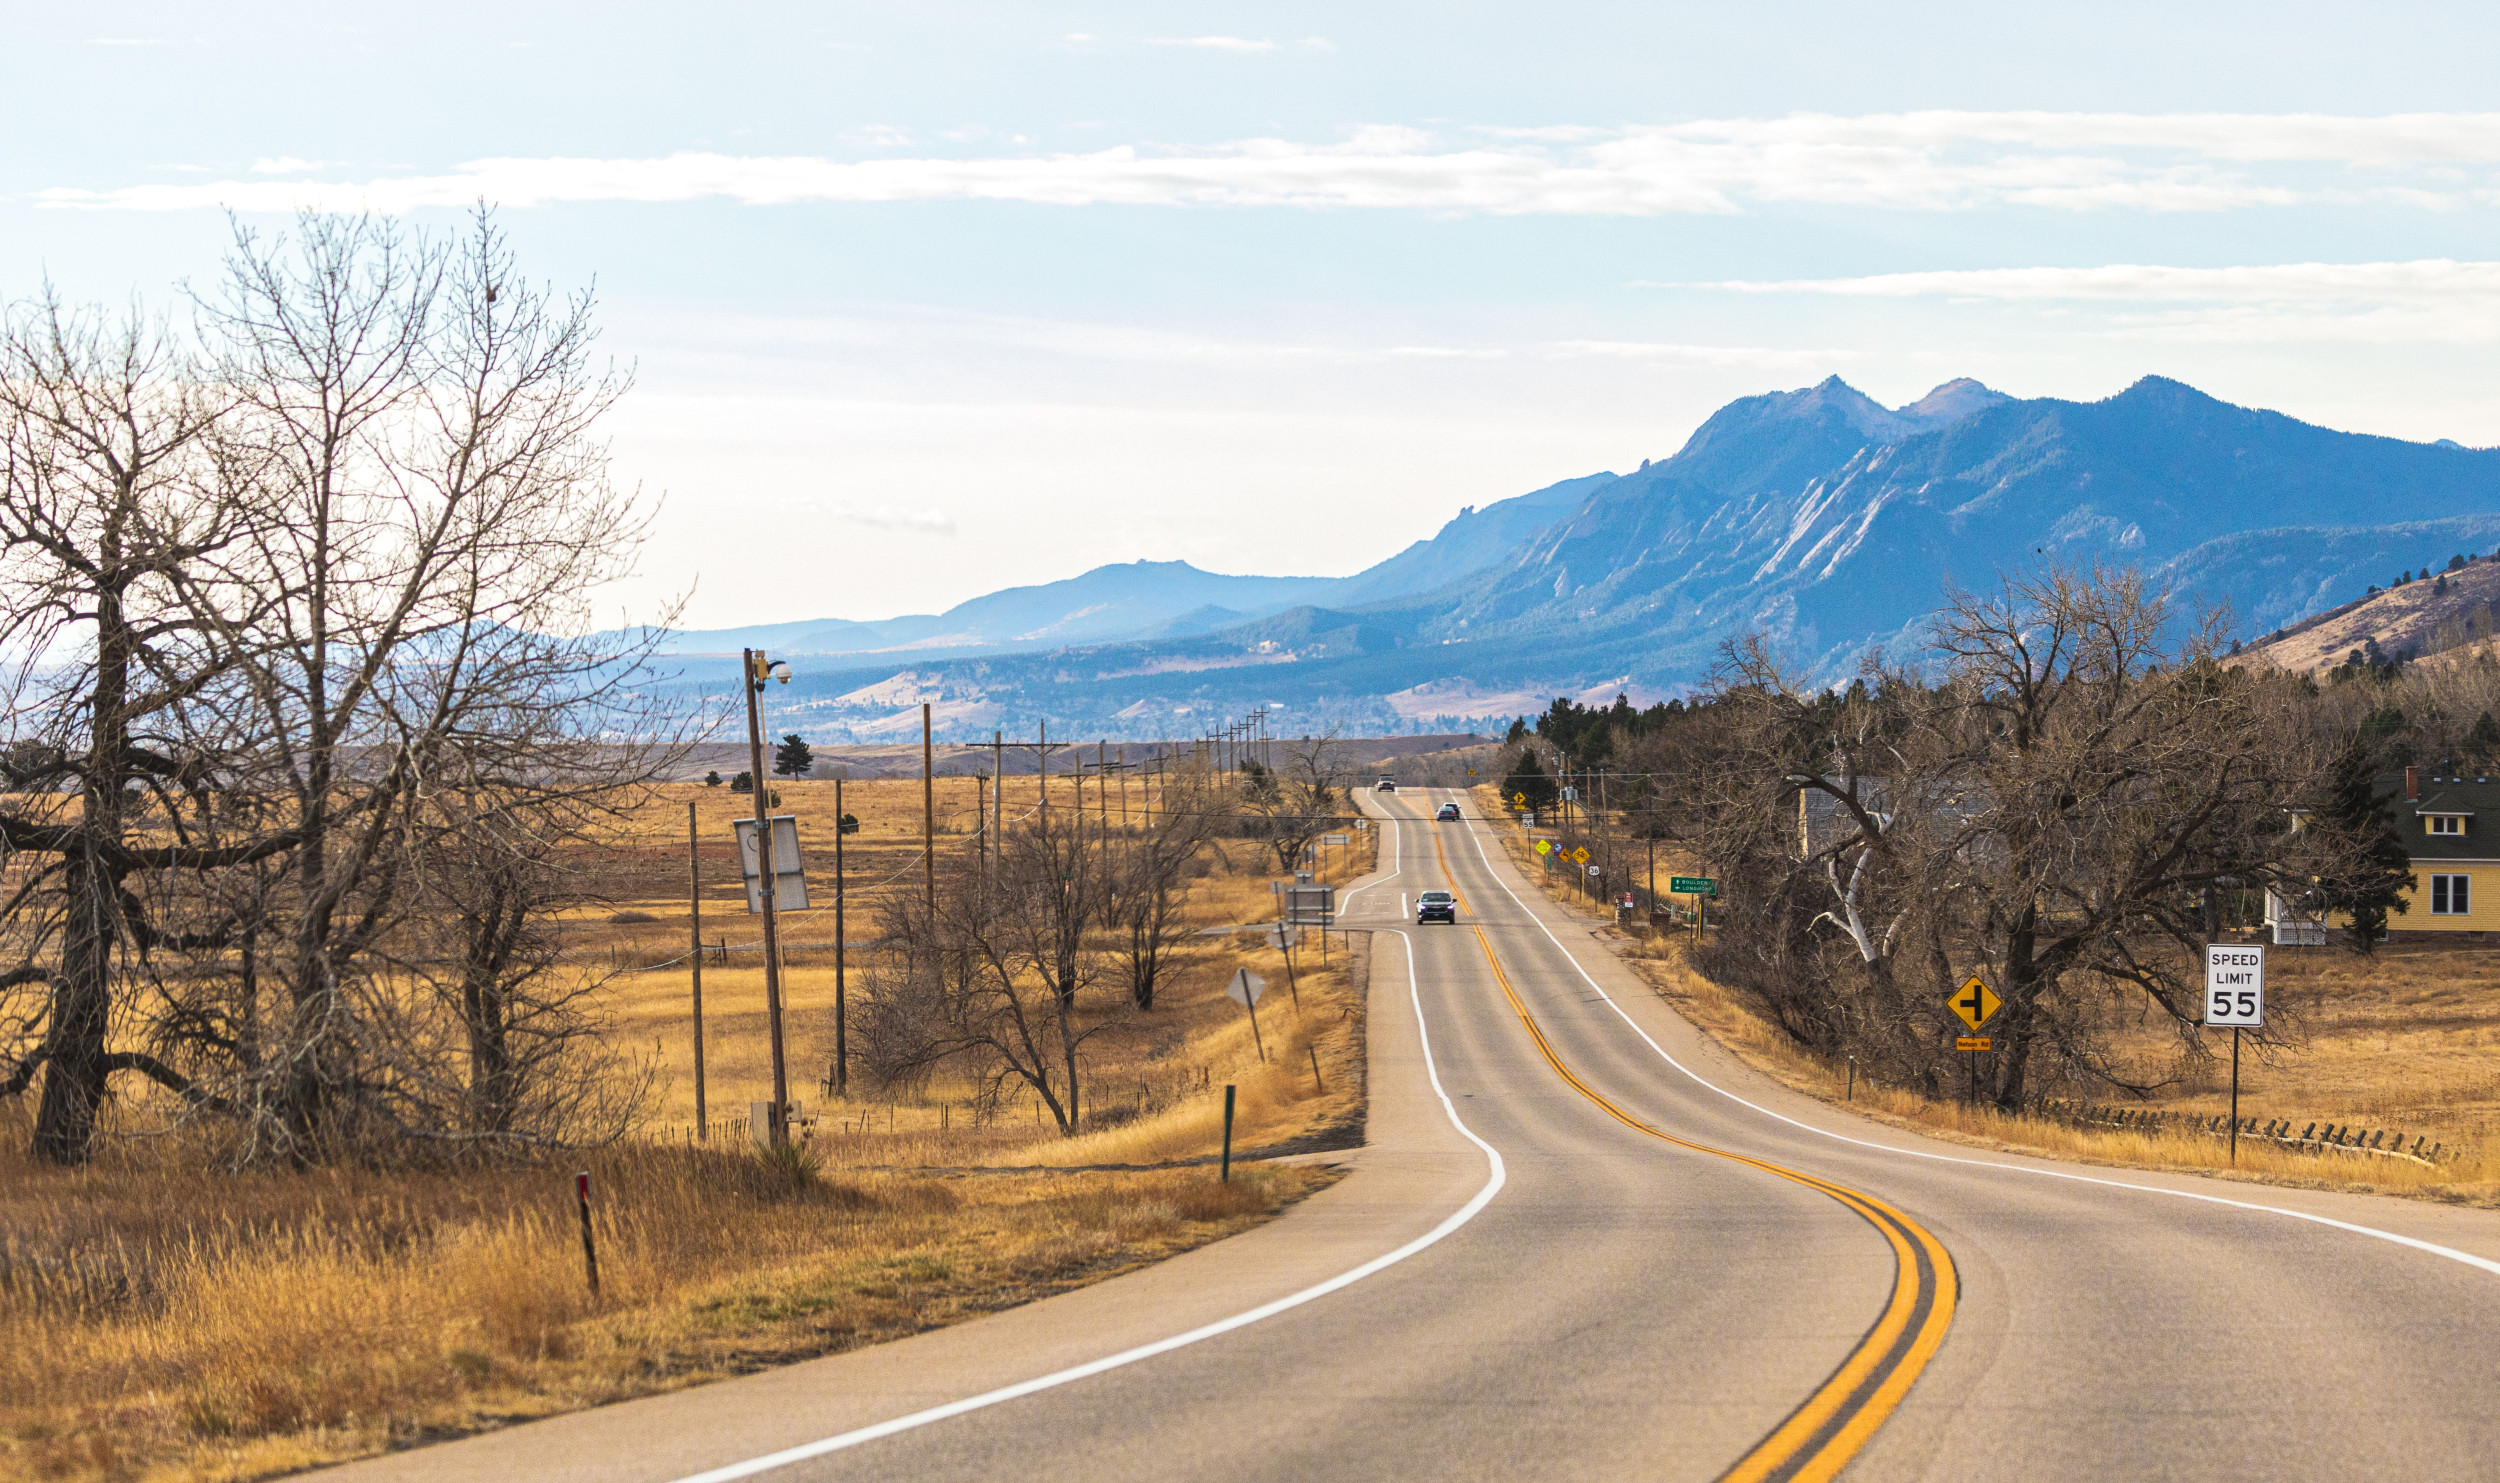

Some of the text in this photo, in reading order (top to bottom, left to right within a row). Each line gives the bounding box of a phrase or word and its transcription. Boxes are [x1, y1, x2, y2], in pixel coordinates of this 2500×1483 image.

[2212, 954, 2258, 965] SPEED
[2217, 973, 2253, 984] LIMIT
[2213, 992, 2256, 1017] 55
